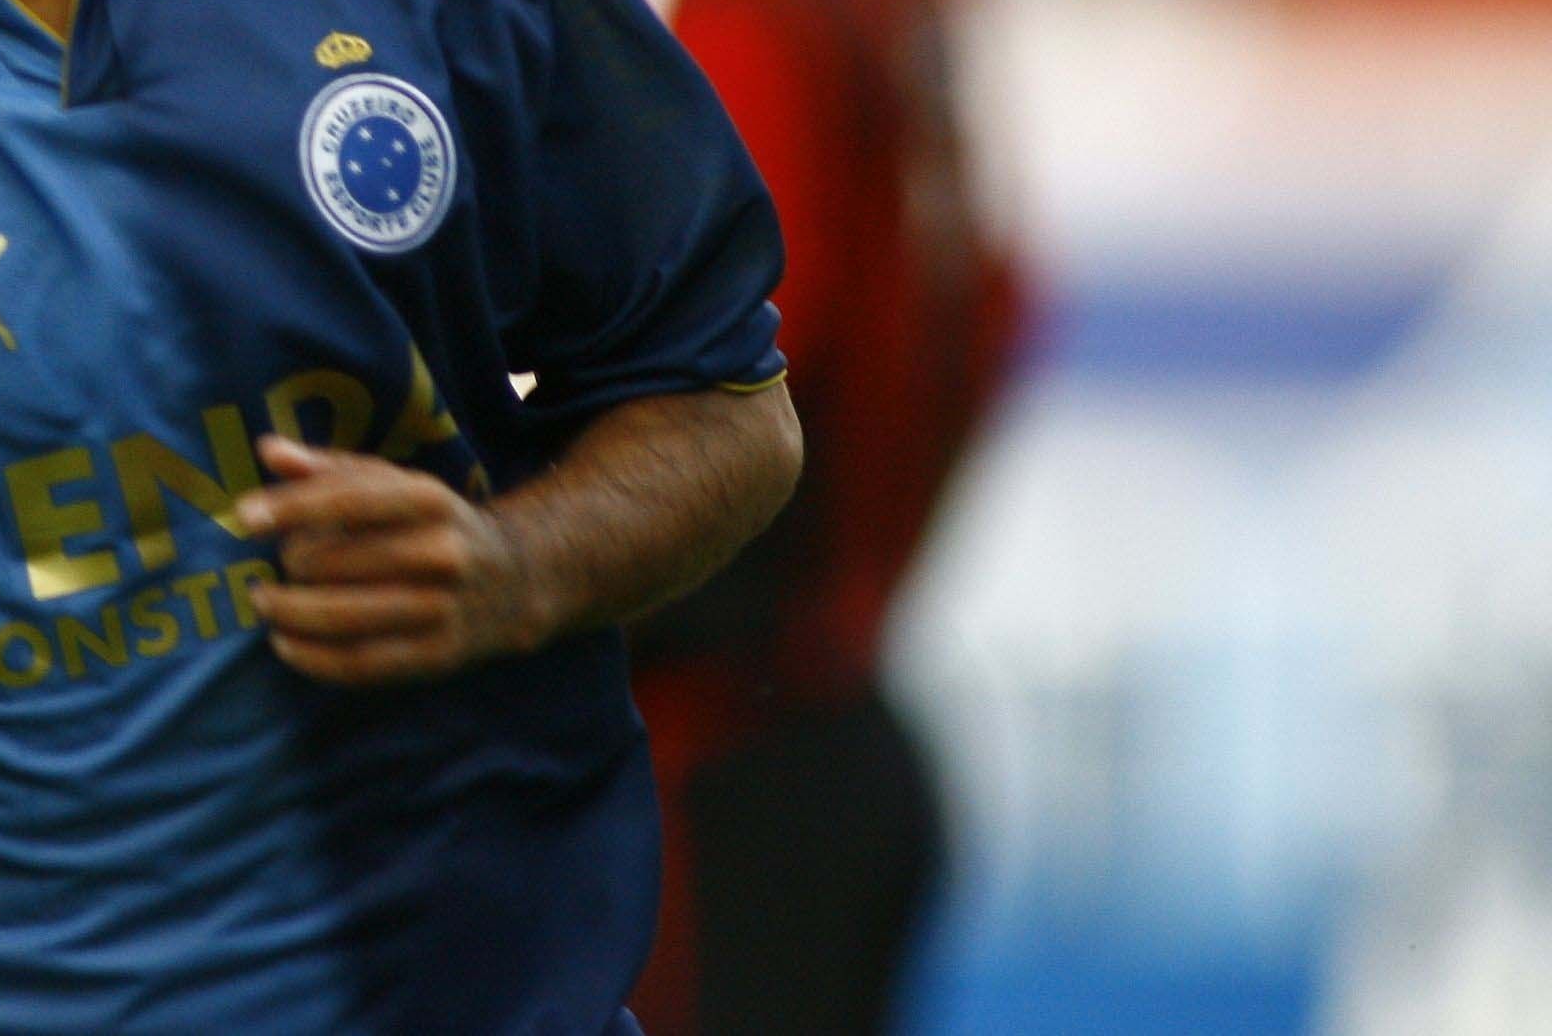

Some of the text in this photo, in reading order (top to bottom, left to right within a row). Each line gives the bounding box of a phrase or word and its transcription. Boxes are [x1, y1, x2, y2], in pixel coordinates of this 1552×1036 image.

[321, 95, 418, 154] CRUZEIRO
[322, 136, 440, 233] ESPORTE CLUBE
